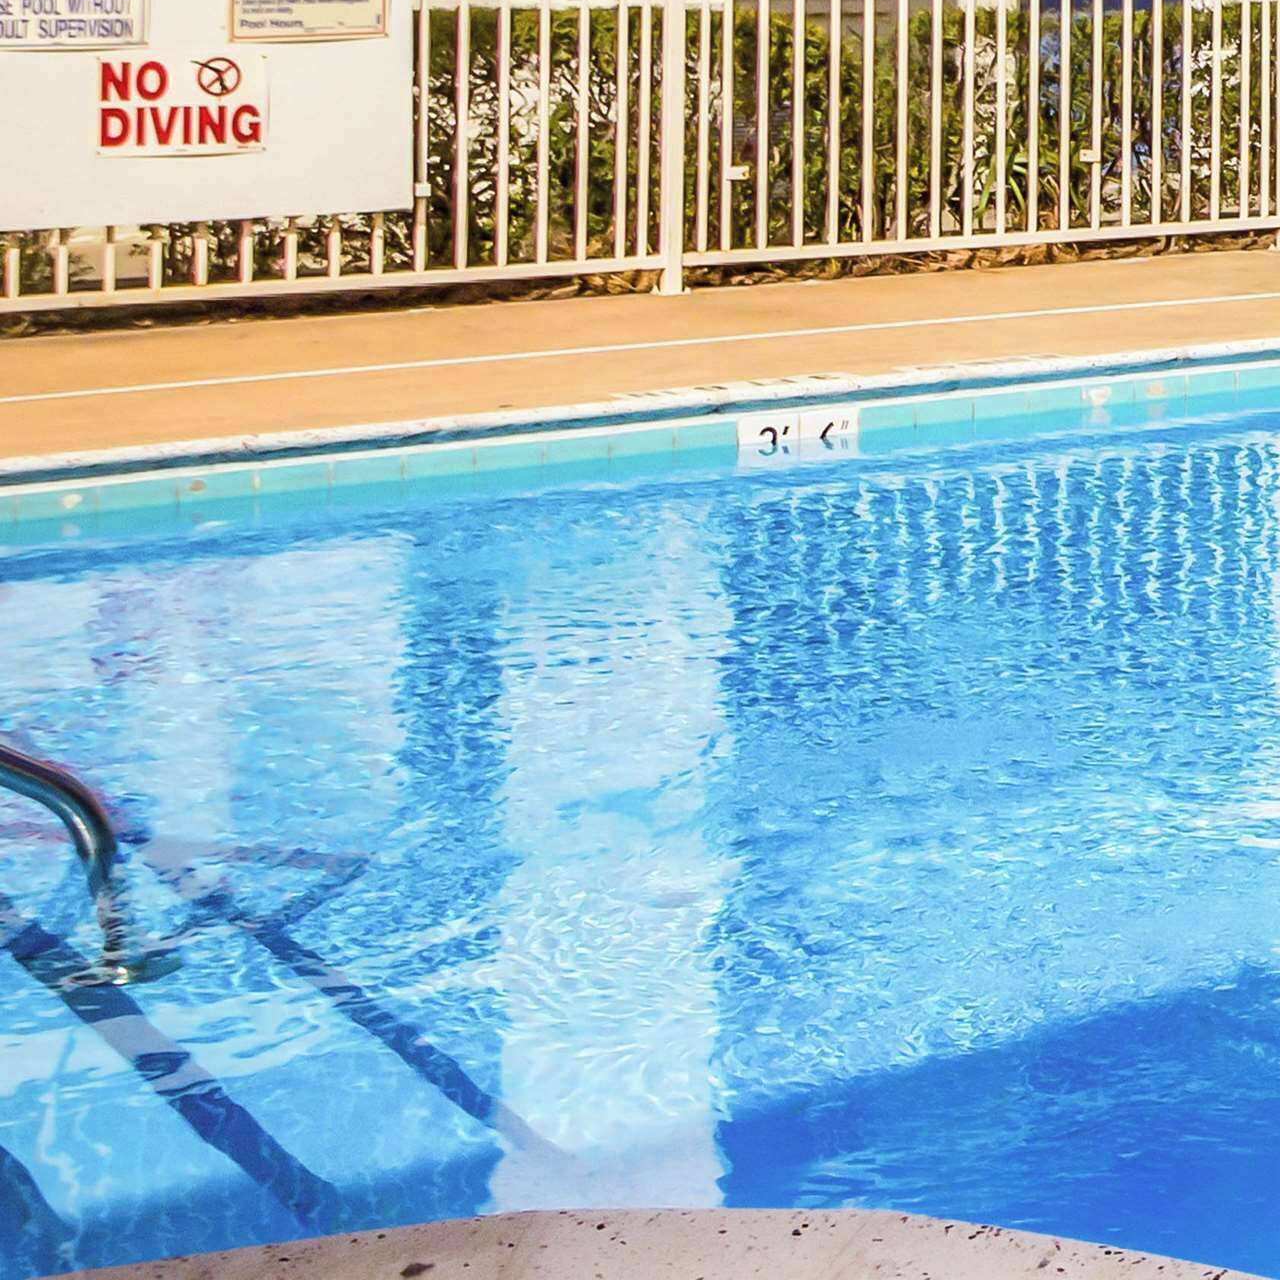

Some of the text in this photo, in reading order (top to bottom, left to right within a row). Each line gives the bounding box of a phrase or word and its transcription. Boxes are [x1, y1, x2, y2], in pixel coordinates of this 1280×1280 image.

[38, 18, 134, 38] SUPERVISION
[101, 60, 168, 101] NO
[101, 104, 262, 147] DIVING
